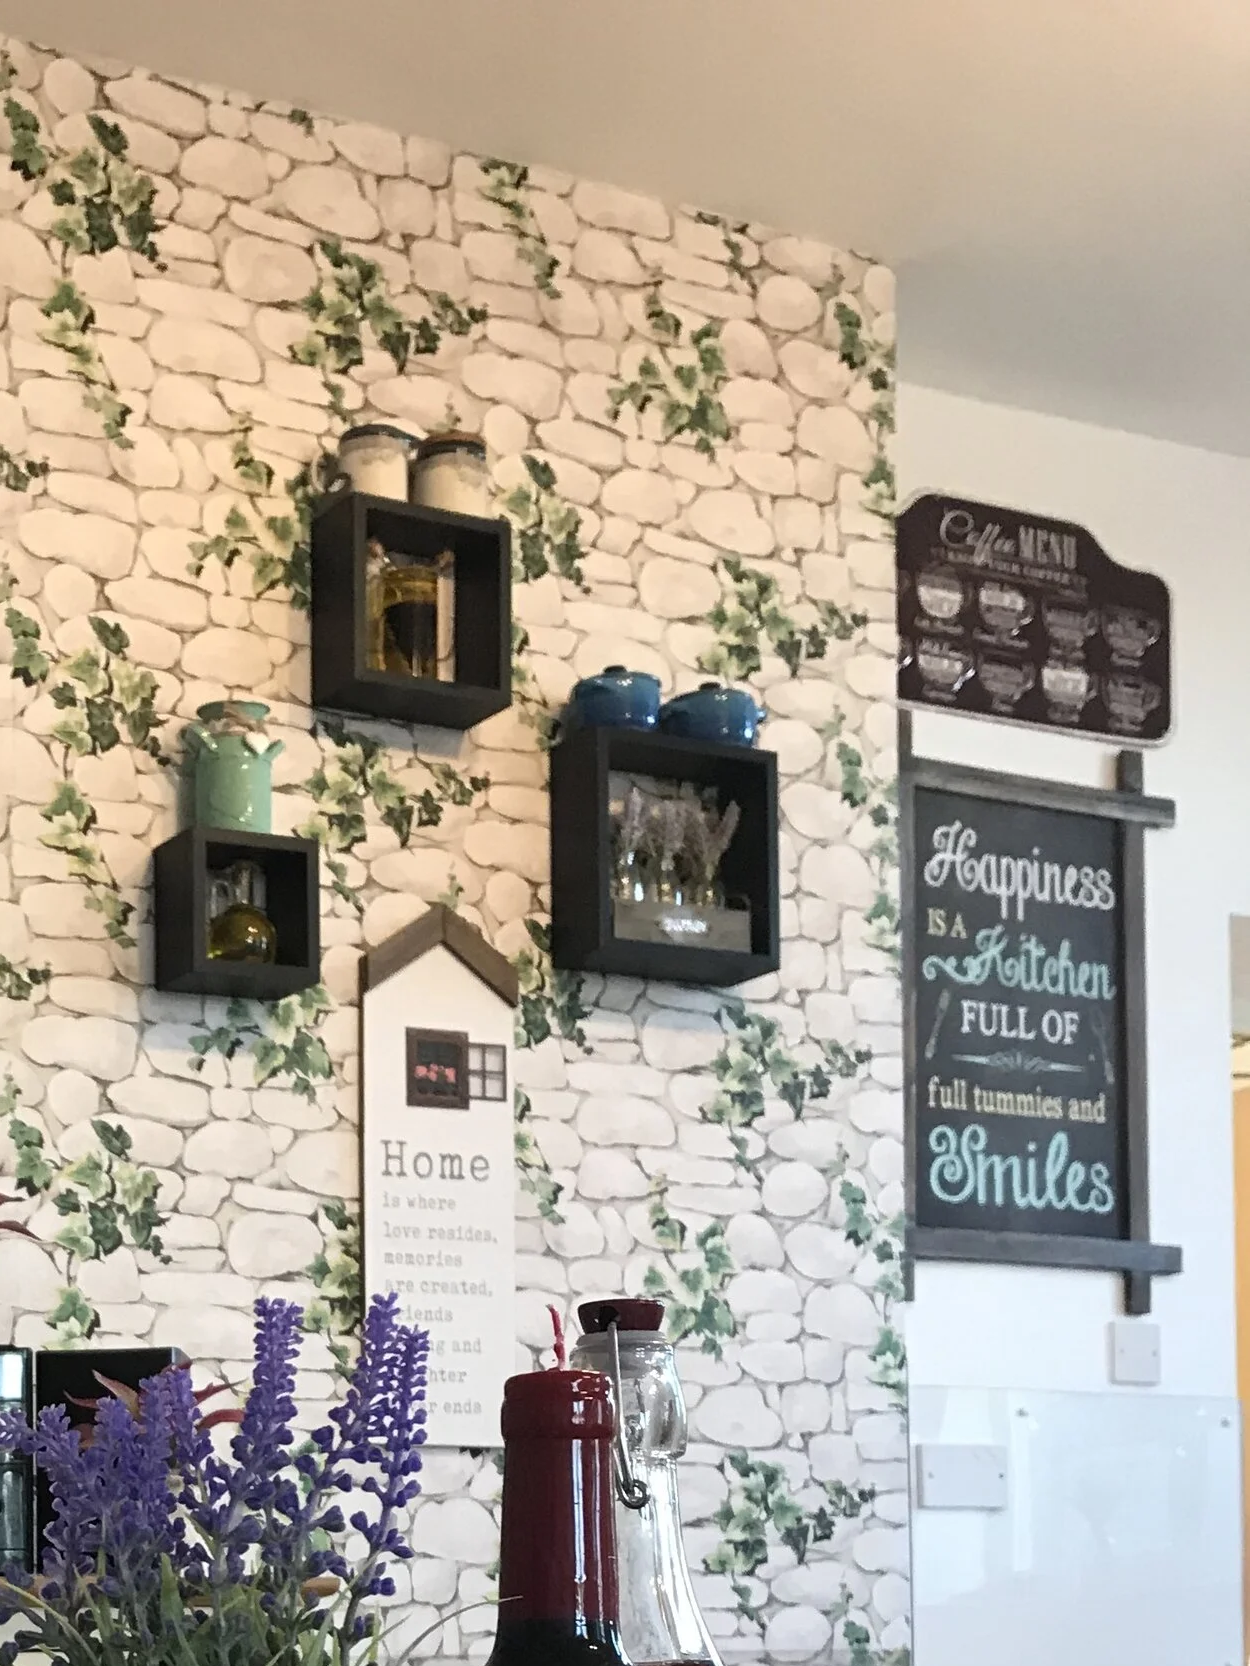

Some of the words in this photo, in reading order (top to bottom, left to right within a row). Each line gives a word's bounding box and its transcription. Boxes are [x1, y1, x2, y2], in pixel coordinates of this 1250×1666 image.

[1019, 524, 1078, 570] MENU
[923, 819, 1116, 922] Happiness
[927, 907, 947, 937] IS
[951, 911, 967, 939] A
[922, 924, 1117, 1000] Kitchen
[960, 999, 1036, 1041] FULL
[1041, 1009, 1080, 1045] OF
[928, 1075, 967, 1111] full
[973, 1084, 1063, 1120] tummies
[1068, 1092, 1106, 1124] and
[380, 1139, 490, 1182] Home
[928, 1123, 1115, 1214] Smiles
[382, 1190, 400, 1208] is
[406, 1193, 456, 1211] where
[383, 1220, 421, 1239] love
[383, 1249, 463, 1267] memories
[385, 1278, 414, 1293] are
[393, 1303, 453, 1322] riends
[452, 1335, 482, 1354] and
[443, 1398, 482, 1415] ends
